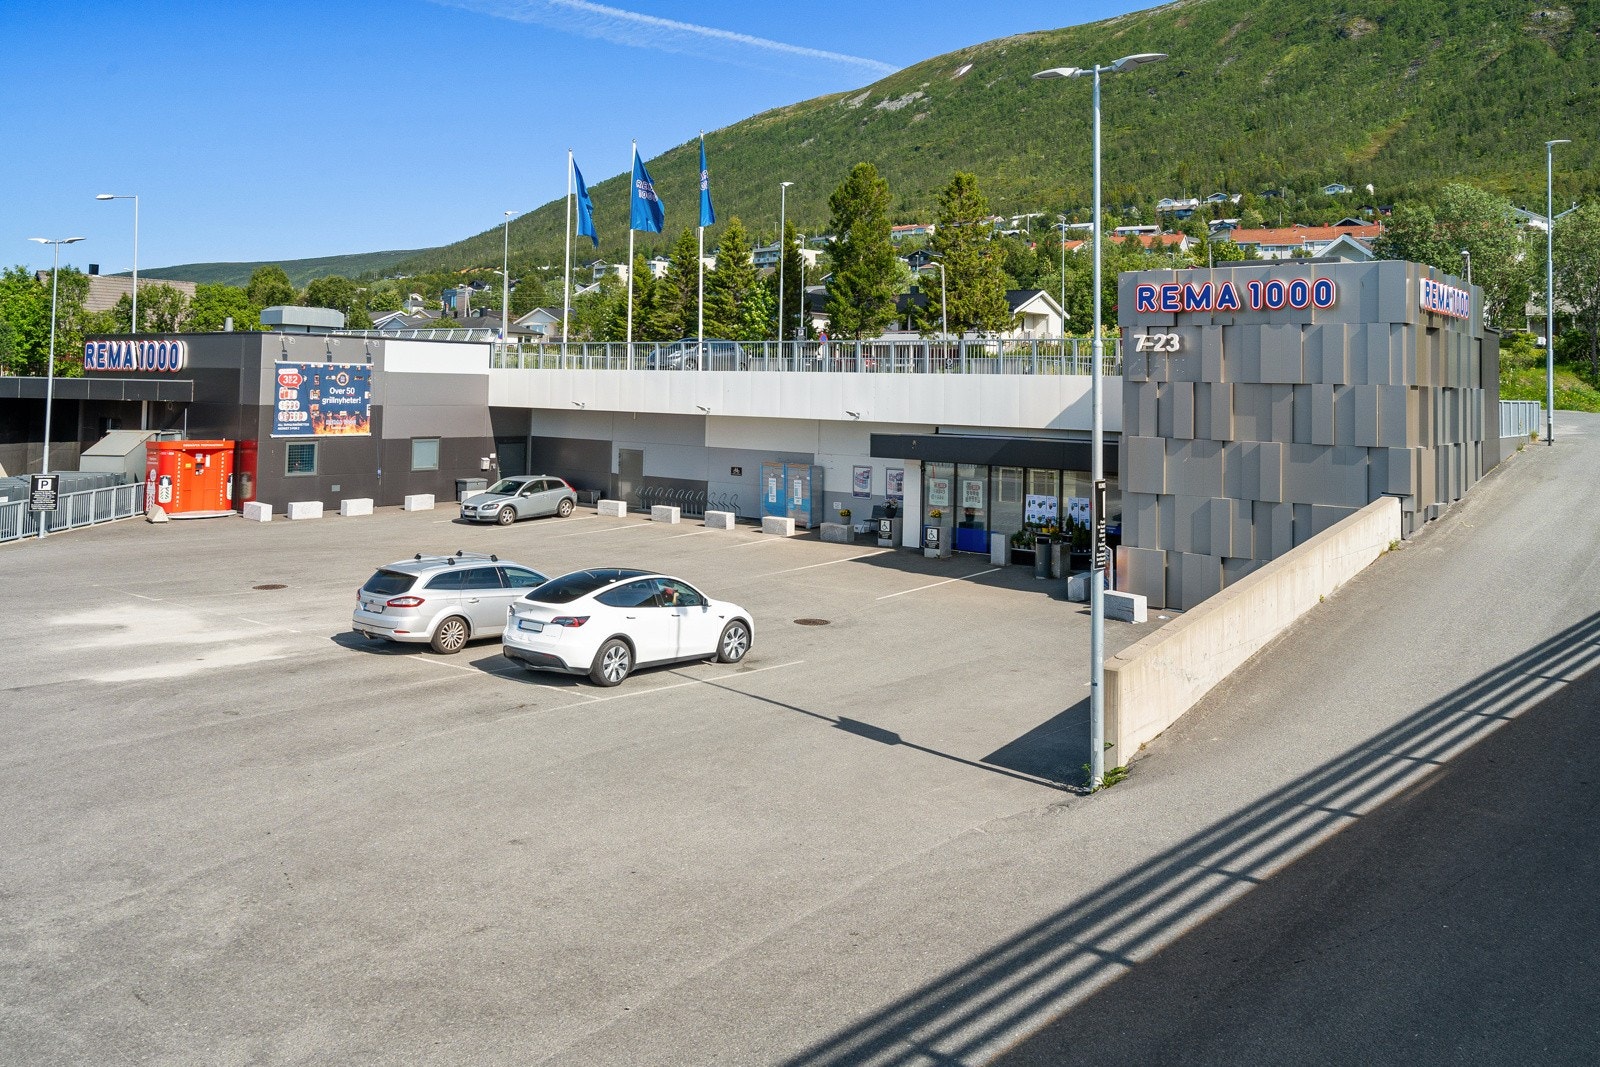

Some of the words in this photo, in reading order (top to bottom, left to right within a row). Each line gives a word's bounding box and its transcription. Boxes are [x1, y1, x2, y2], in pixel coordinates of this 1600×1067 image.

[1137, 282, 1241, 313] REMA
[1248, 278, 1336, 312] 1000
[1421, 277, 1450, 316] REMA
[1450, 286, 1470, 320] 1000
[1134, 333, 1180, 353] 7-23
[84, 339, 137, 372] REMA
[138, 339, 183, 373] 1000
[283, 375, 288, 384] 3
[292, 375, 298, 384] 2
[330, 387, 345, 395] Over
[346, 387, 355, 395] 50
[322, 397, 362, 405] grillnyheter!
[40, 480, 49, 489] P
